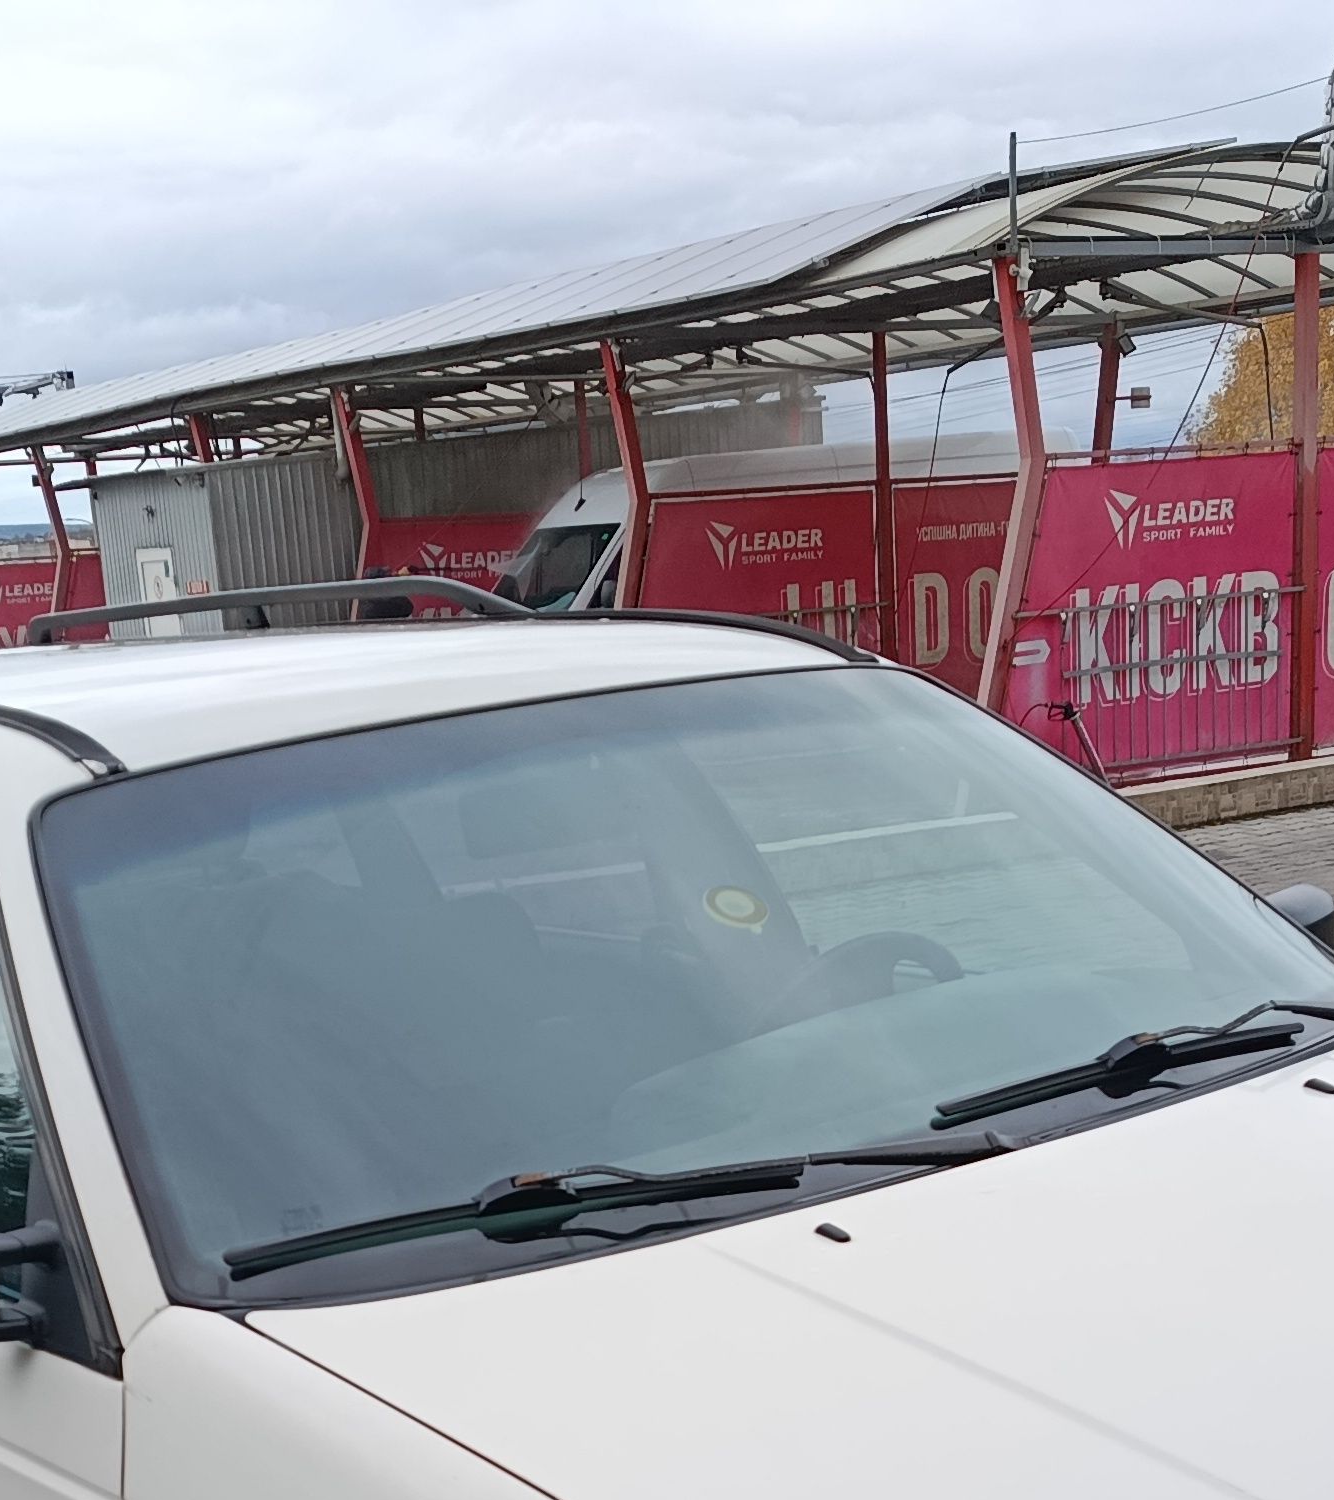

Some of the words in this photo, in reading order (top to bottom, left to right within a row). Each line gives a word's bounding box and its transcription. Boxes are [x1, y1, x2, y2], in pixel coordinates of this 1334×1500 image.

[1143, 498, 1235, 527] LEADER
[959, 521, 995, 540] ДИТИНА
[1143, 529, 1182, 542] SPORT
[1189, 523, 1235, 537] FAMILY
[741, 529, 823, 552] LEADER
[742, 553, 777, 565] SPORT
[784, 550, 823, 562] FAMILY
[6, 583, 53, 596] LEADE
